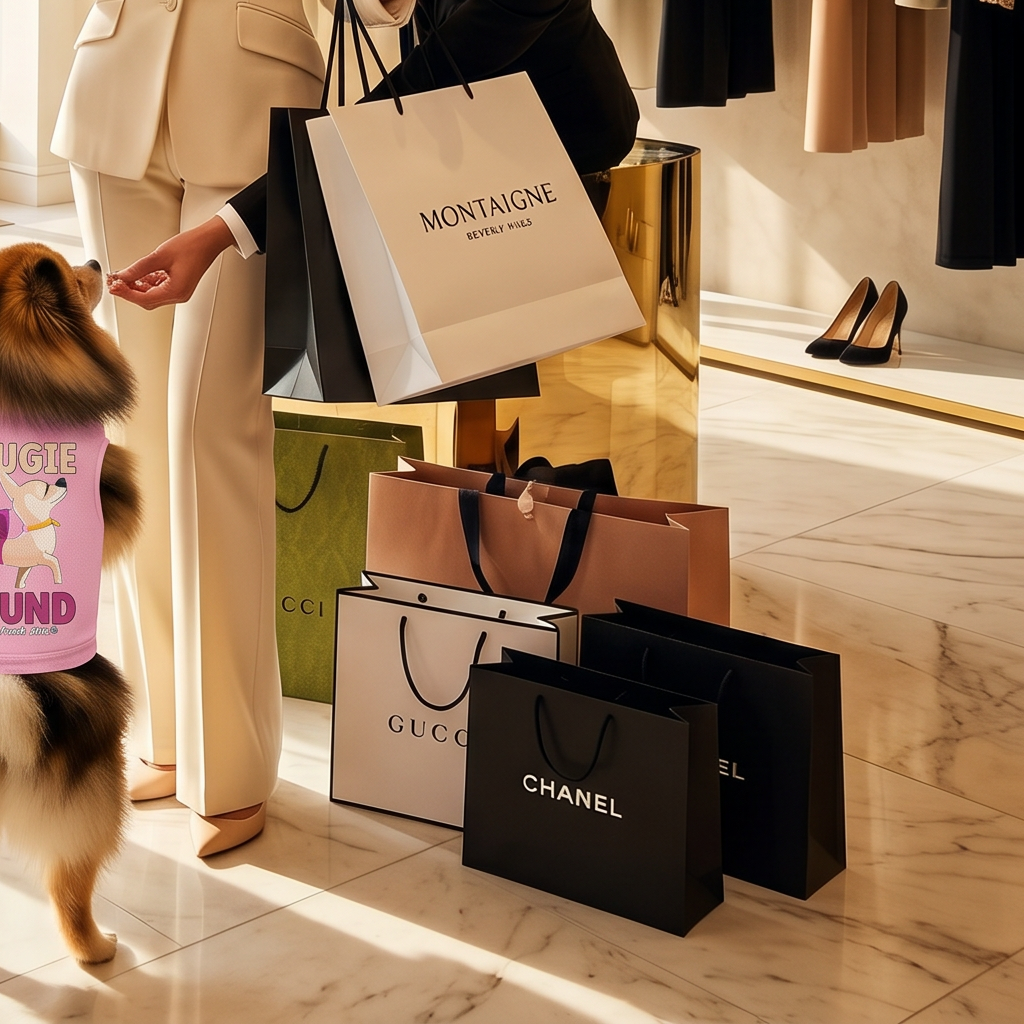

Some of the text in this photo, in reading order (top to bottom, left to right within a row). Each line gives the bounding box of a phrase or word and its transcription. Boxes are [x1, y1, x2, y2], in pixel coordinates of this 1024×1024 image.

[419, 182, 558, 233] MONTAIGNE
[466, 224, 504, 241] BEVERLY
[281, 596, 323, 617] CCI
[388, 714, 468, 748] GUCC
[522, 774, 623, 819] CHANEL
